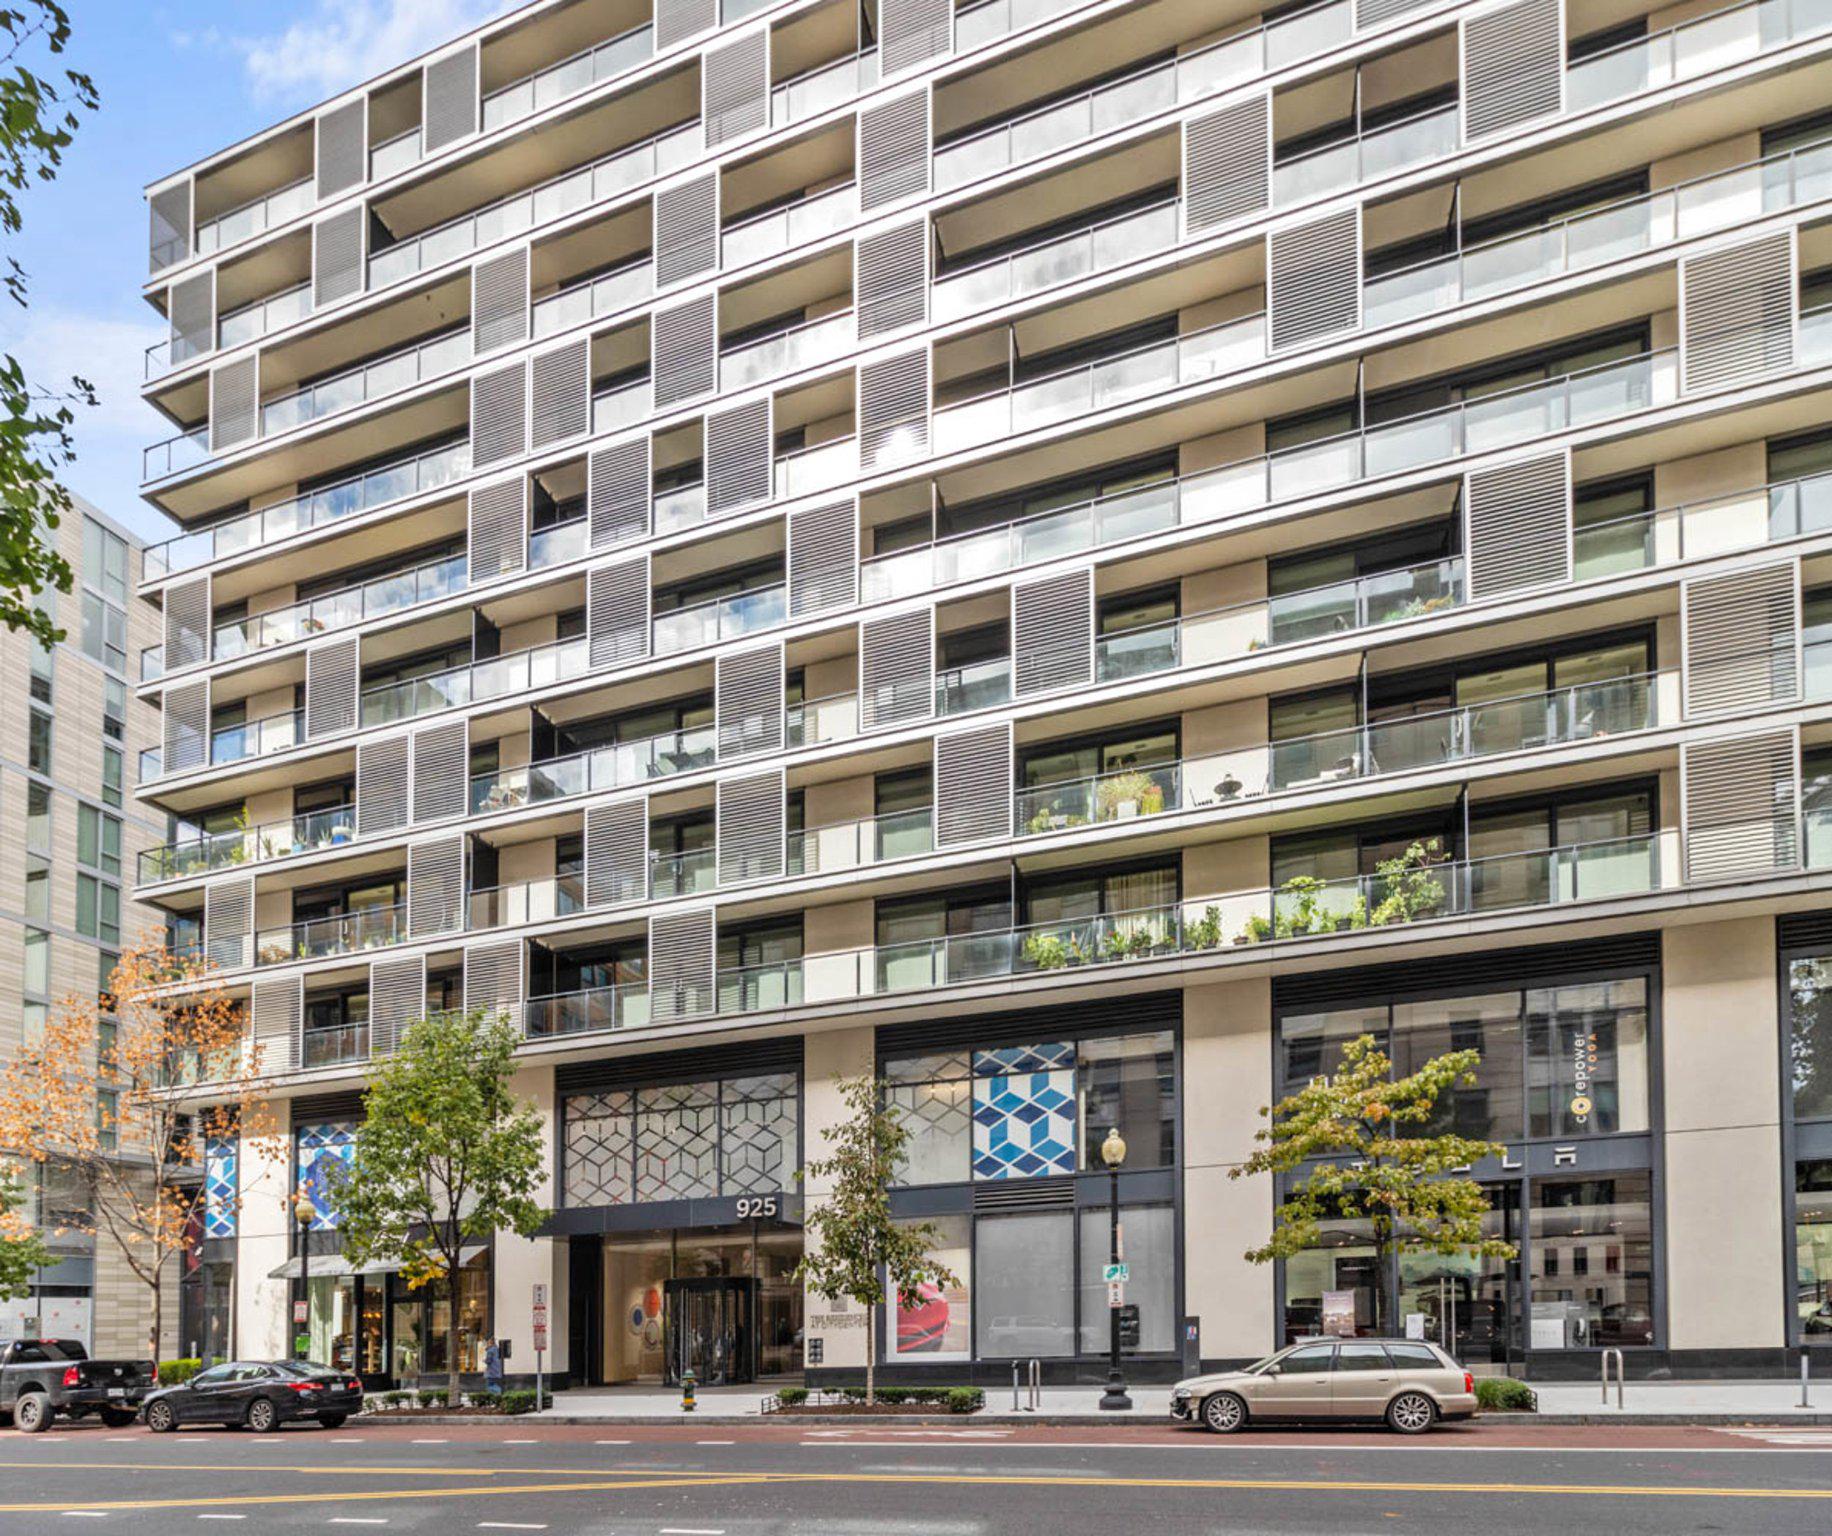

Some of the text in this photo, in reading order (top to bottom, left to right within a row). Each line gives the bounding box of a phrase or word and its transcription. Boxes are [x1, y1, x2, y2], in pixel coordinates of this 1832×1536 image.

[1570, 1032, 1592, 1124] corepower
[1350, 1147, 1577, 1175] TLA
[736, 1197, 776, 1219] 925
